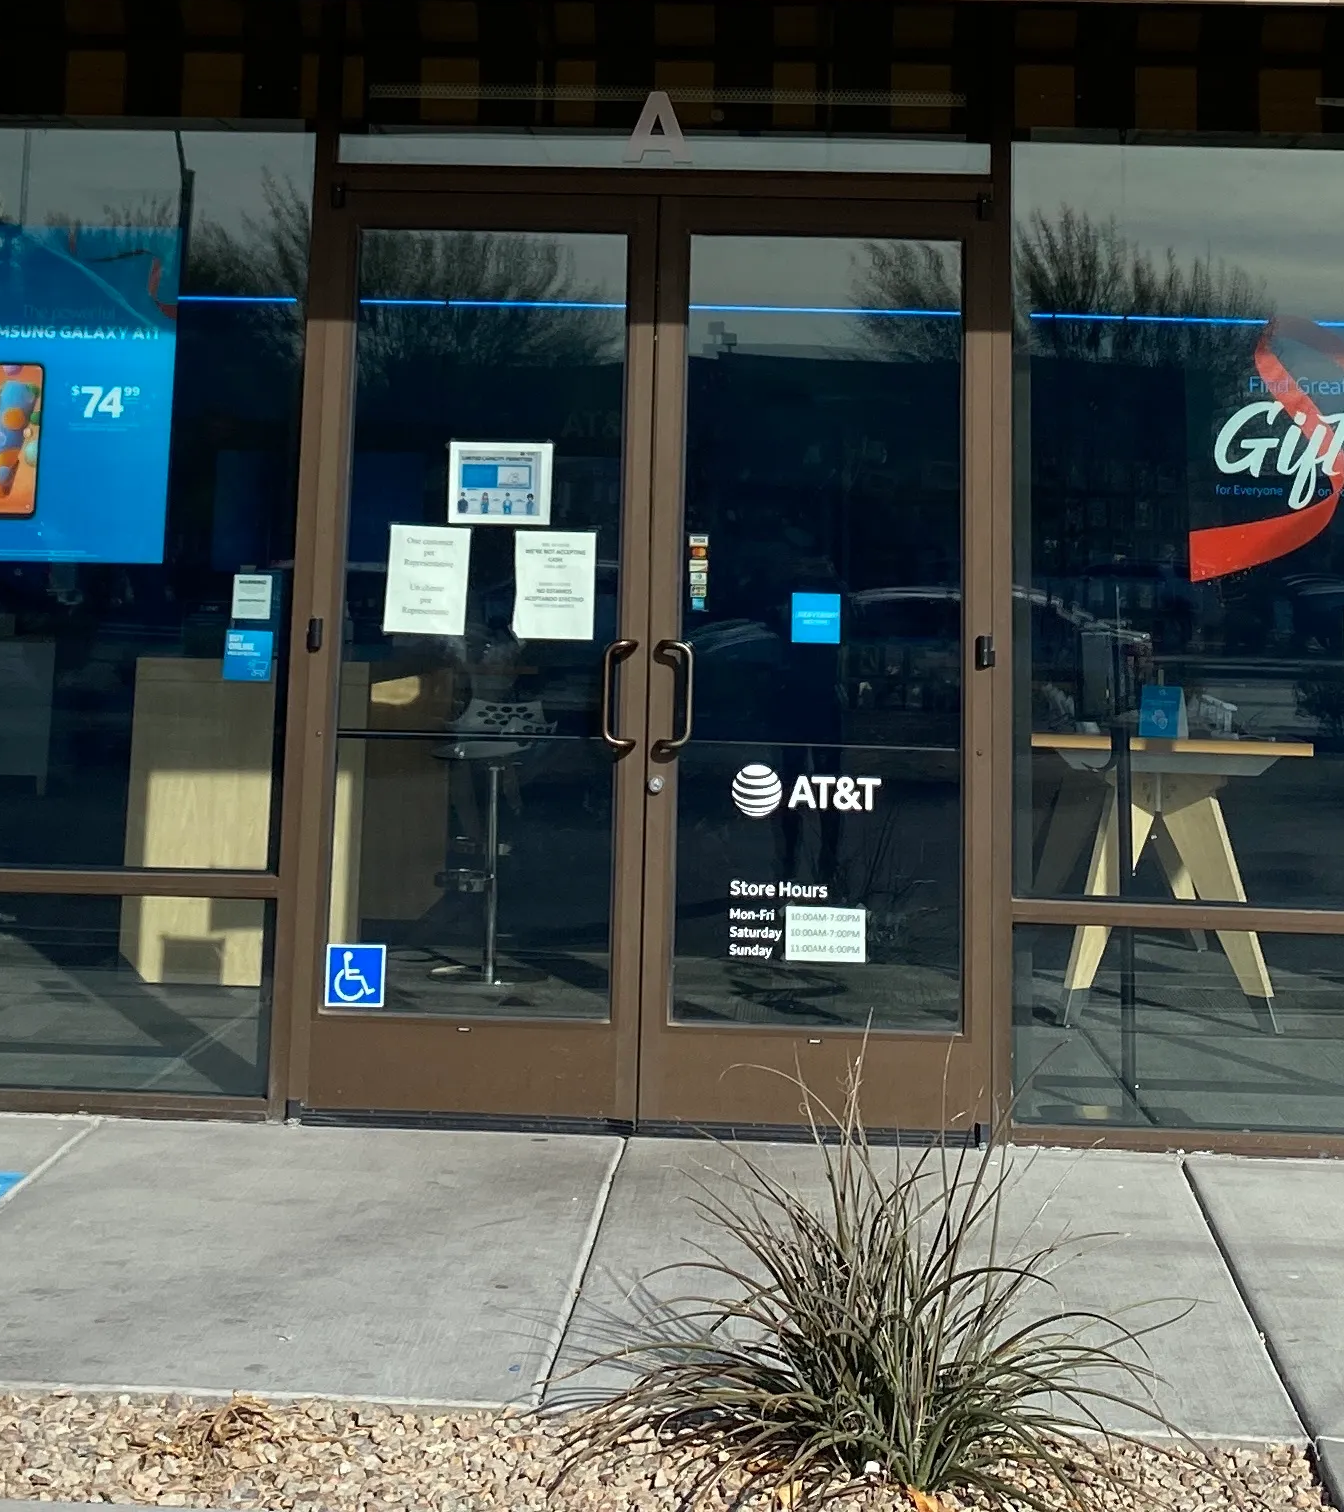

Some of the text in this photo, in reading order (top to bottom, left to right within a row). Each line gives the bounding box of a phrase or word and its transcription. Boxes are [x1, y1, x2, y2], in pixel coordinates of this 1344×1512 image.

[622, 91, 693, 163] A
[60, 327, 127, 340] GALAXY
[132, 327, 160, 340] A11
[1249, 376, 1289, 393] Find
[1216, 484, 1231, 495] for
[1234, 485, 1283, 499] Everyone
[787, 774, 882, 811] AT&T
[730, 880, 828, 898] Store Hours
[729, 908, 775, 921] Mon-Fri
[729, 926, 782, 942] Saturday
[729, 943, 773, 959] Sunday
